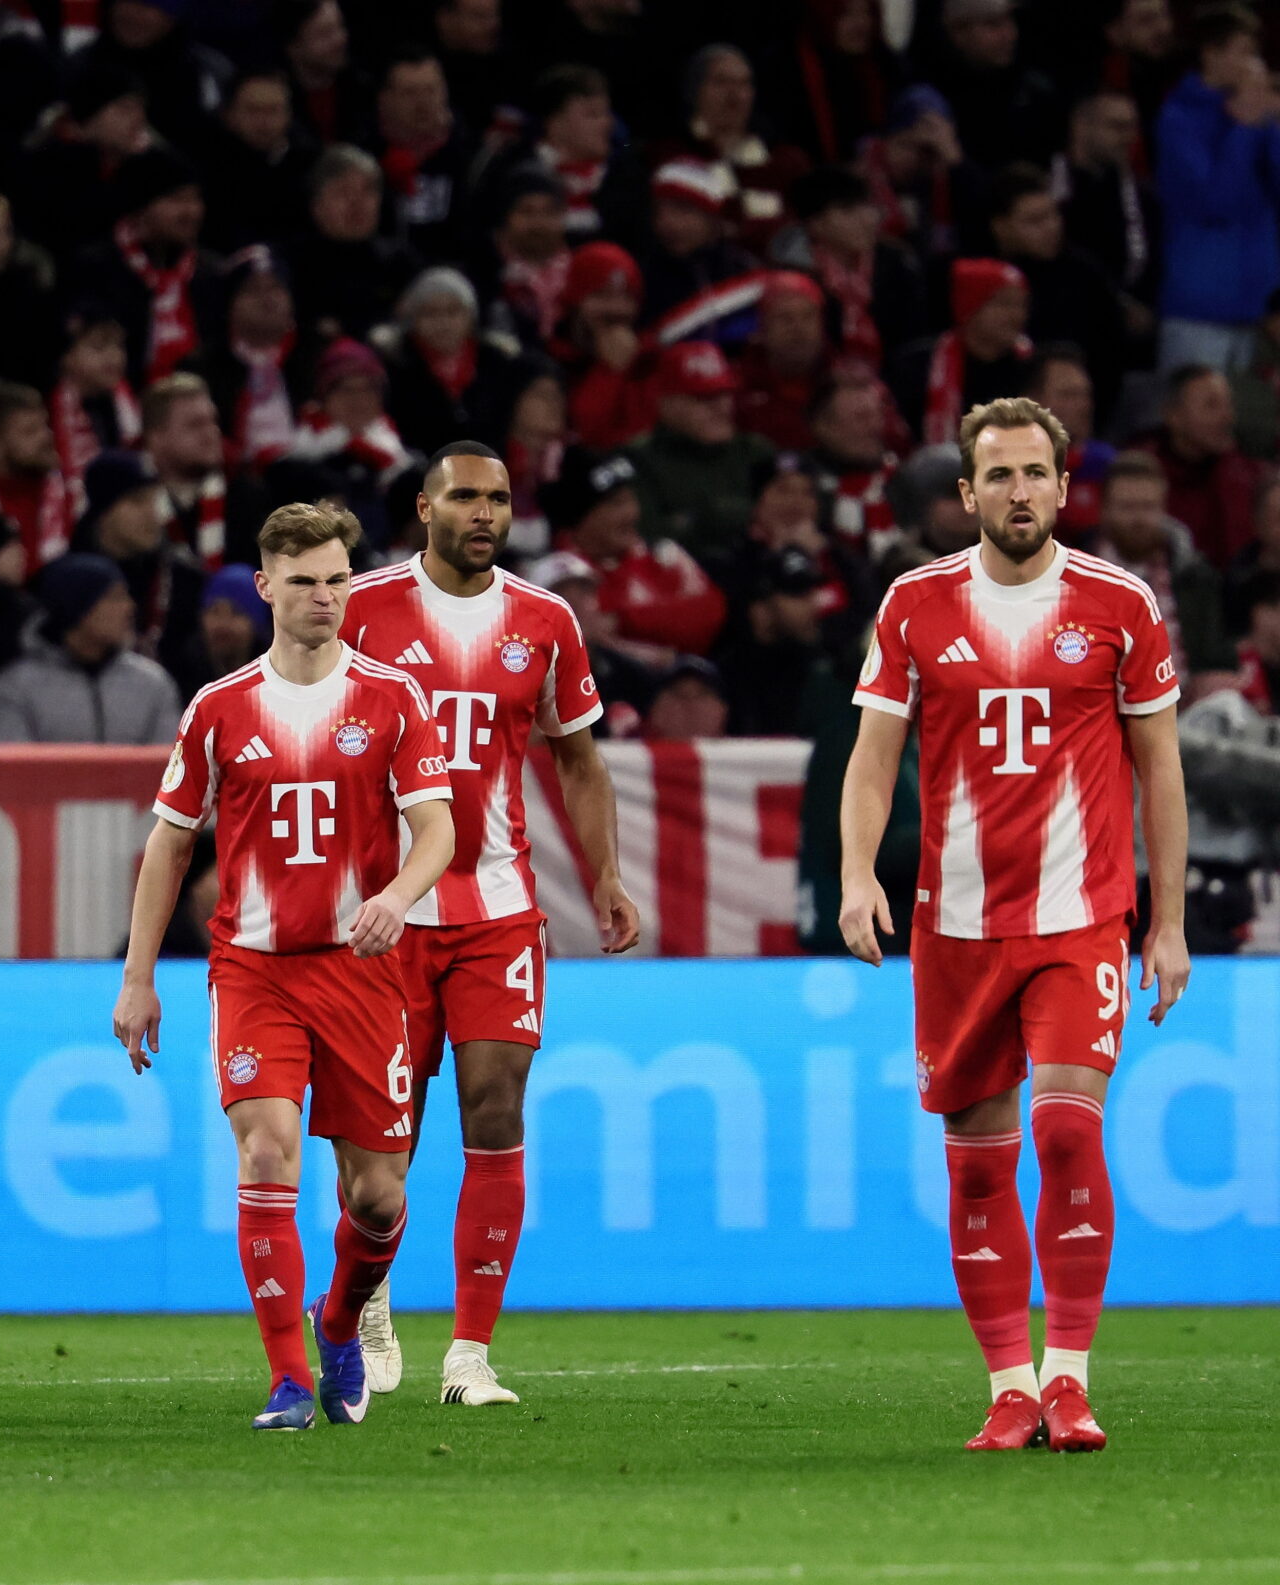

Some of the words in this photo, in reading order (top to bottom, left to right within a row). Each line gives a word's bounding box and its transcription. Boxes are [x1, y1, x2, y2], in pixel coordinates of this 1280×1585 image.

[978, 688, 1051, 775] T
[271, 780, 336, 865] T
[506, 946, 534, 1002] 4
[1095, 962, 1119, 1020] 9
[386, 1042, 411, 1104] 6
